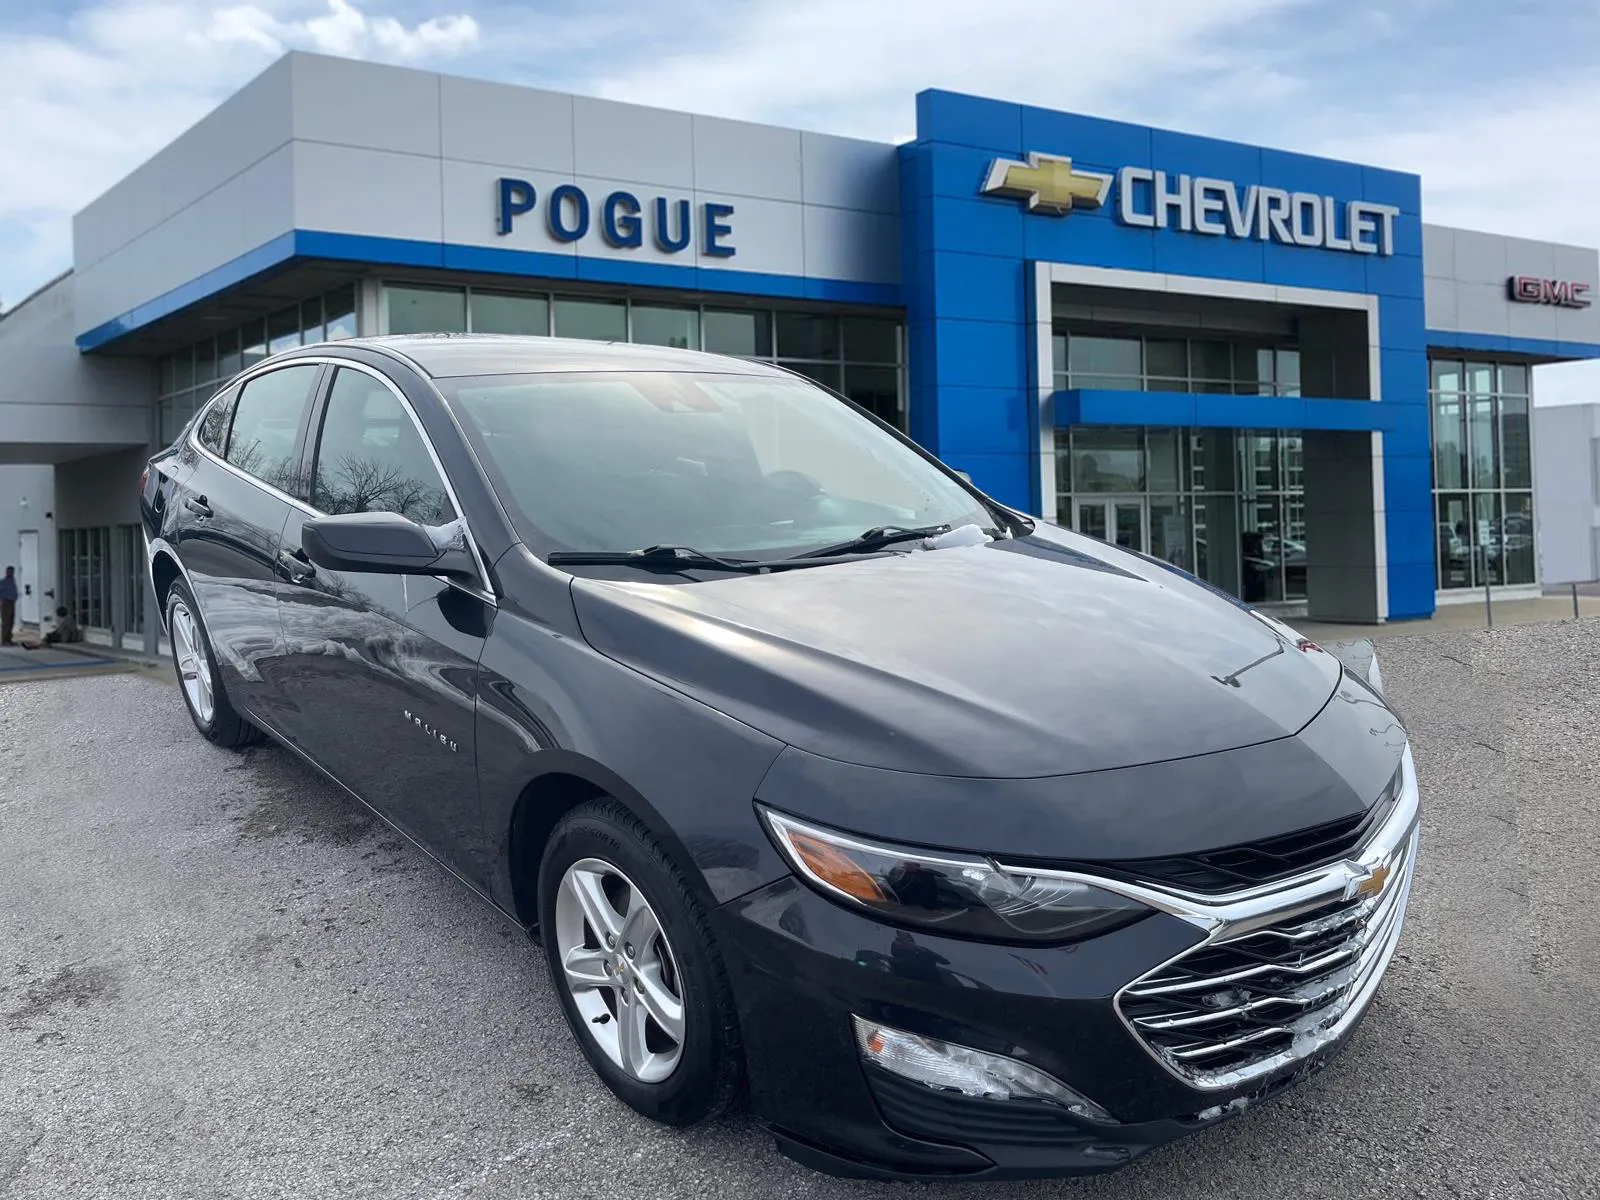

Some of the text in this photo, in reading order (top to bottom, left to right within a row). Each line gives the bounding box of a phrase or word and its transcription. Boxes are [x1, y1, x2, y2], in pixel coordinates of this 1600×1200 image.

[497, 177, 736, 257] POGUE
[1118, 165, 1400, 256] CHEVROLET
[1508, 275, 1592, 309] GMC
[404, 709, 458, 753] MALIBU
